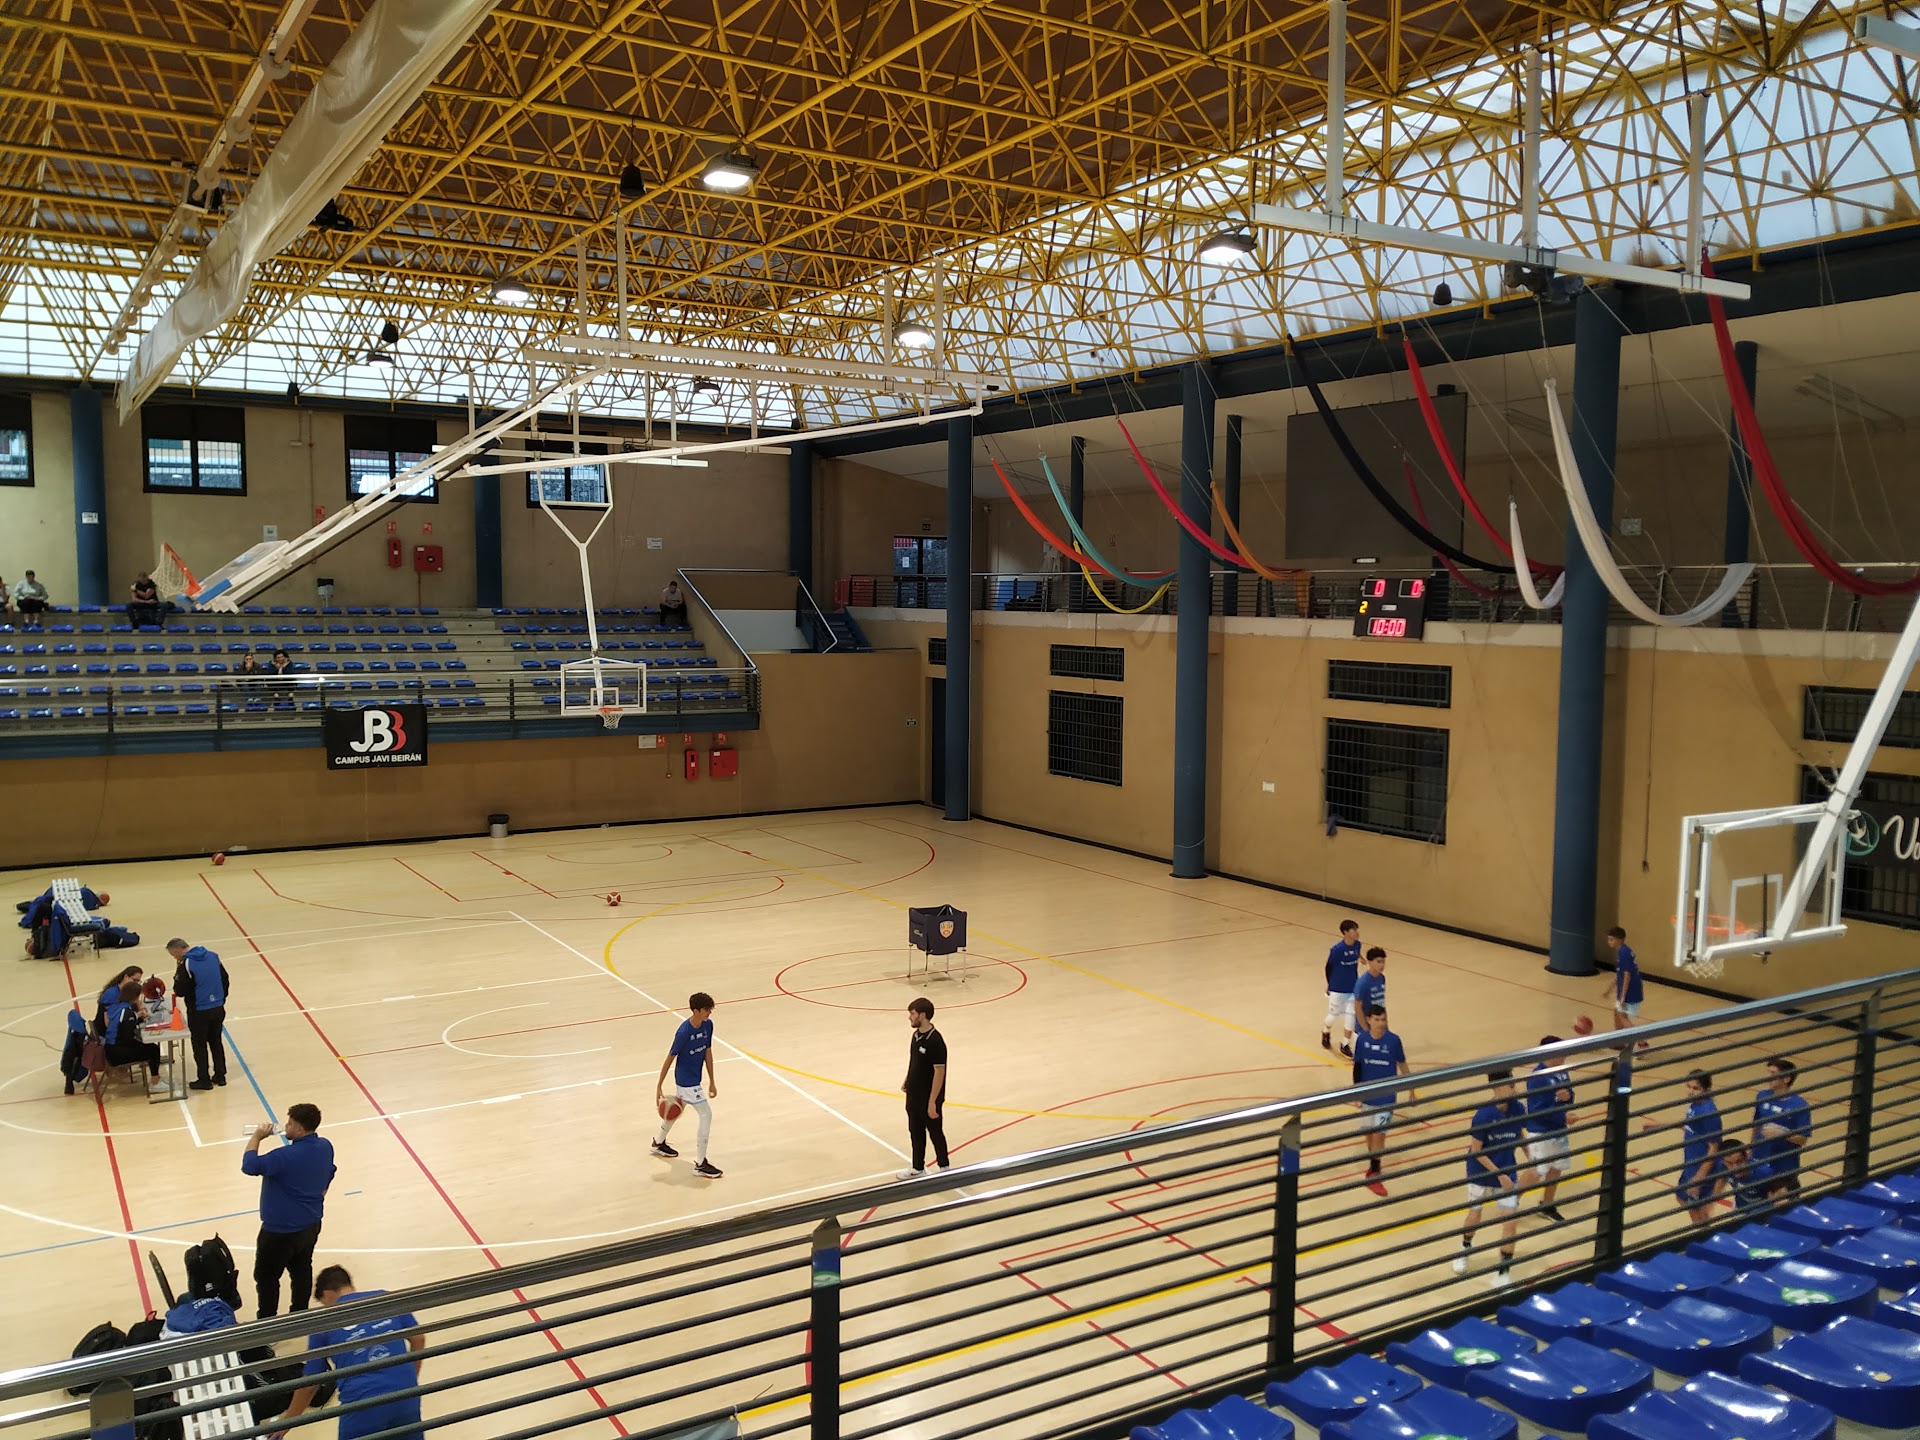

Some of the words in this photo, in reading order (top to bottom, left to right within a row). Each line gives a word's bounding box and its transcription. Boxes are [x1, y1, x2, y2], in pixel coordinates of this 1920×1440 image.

[1374, 579, 1386, 597] 0
[1411, 579, 1423, 597] 0
[1359, 600, 1369, 614] 2
[1371, 618, 1406, 637] 10:00
[335, 755, 370, 764] CAMPUS
[372, 754, 390, 763] JAVI
[391, 753, 421, 762] BEIRÁN
